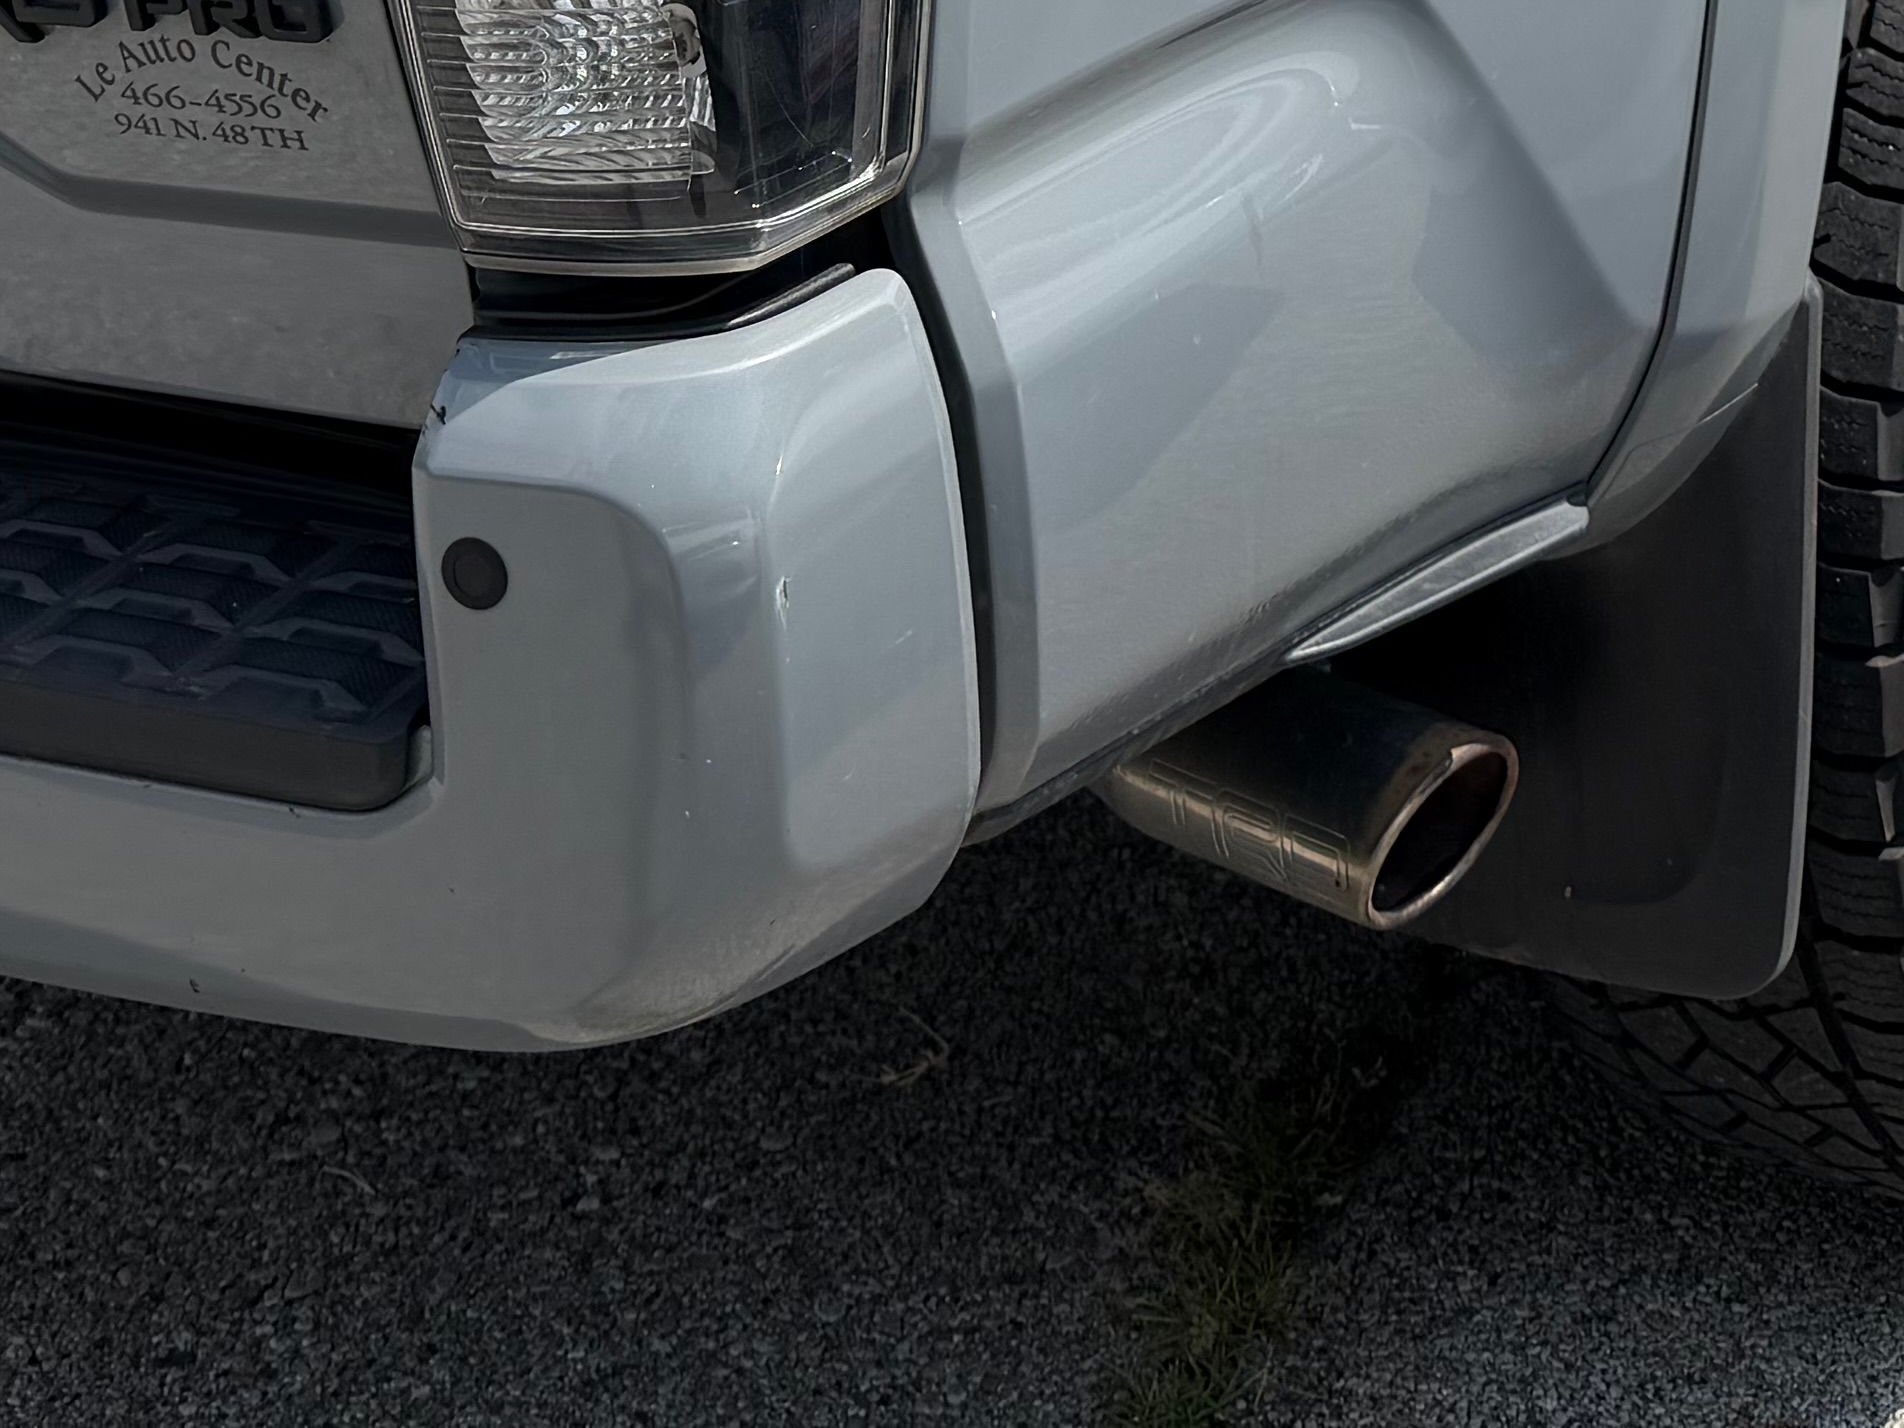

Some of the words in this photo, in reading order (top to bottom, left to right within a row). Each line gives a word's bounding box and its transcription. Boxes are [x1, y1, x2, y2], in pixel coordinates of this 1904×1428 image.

[74, 61, 116, 103] Le
[117, 34, 196, 74] Auto
[210, 38, 329, 123] Center
[119, 81, 283, 120] 466-4556
